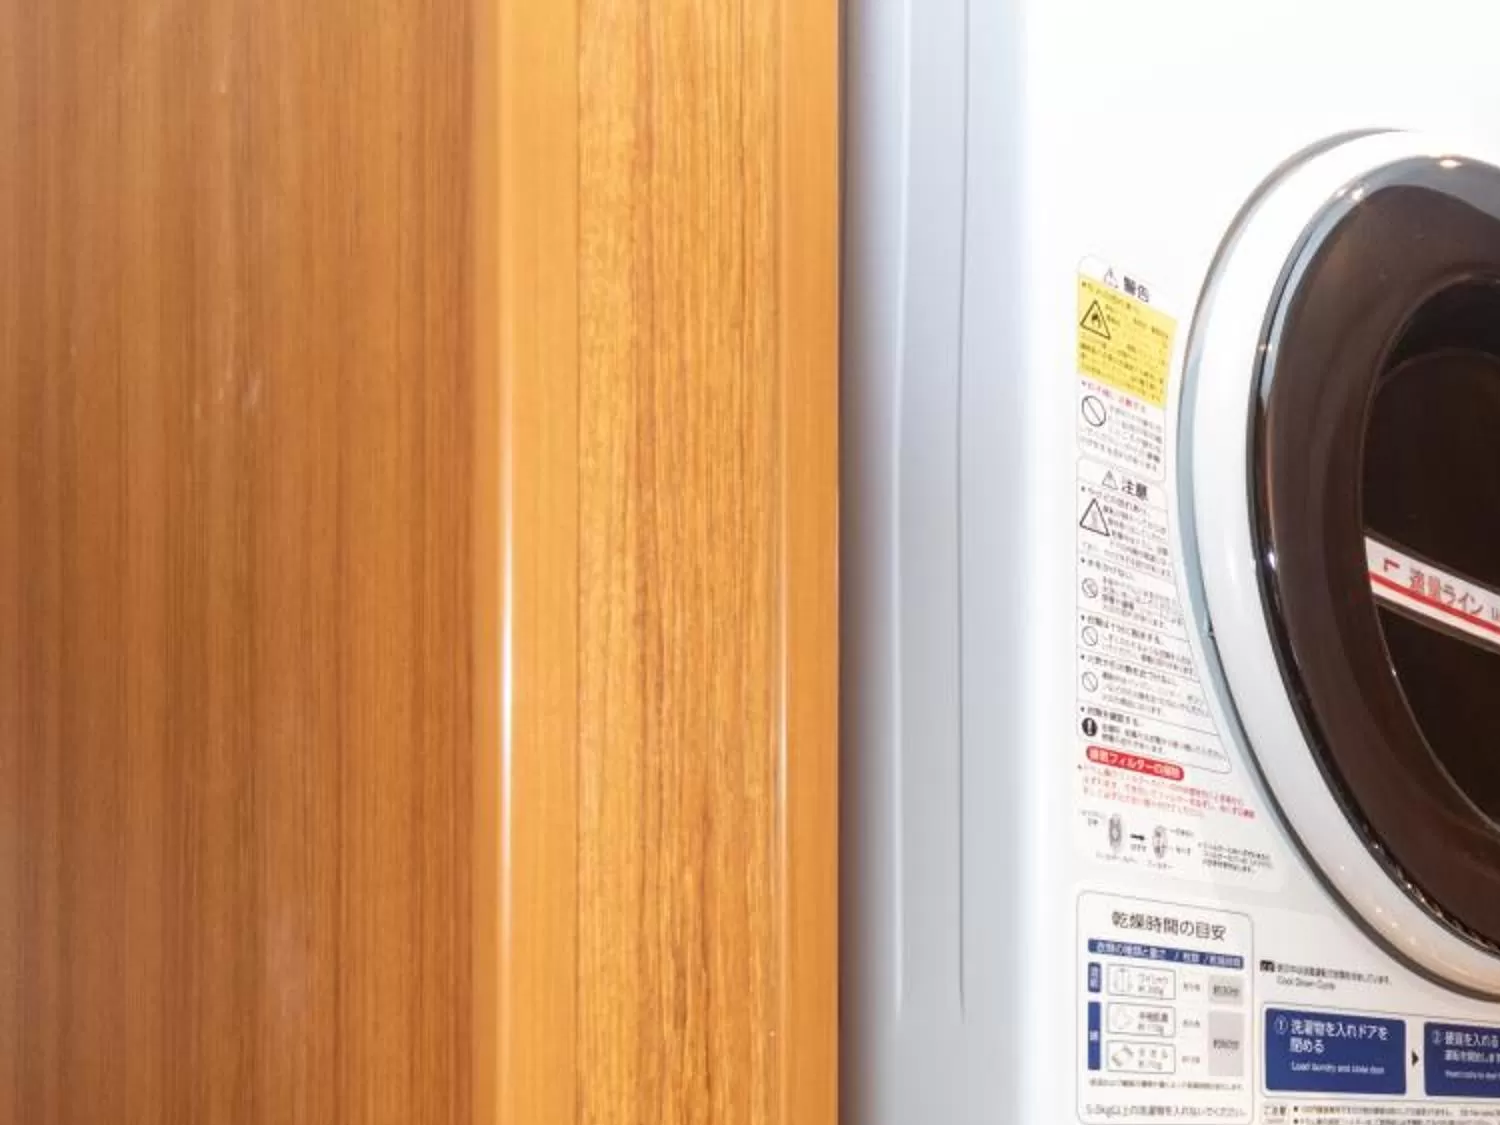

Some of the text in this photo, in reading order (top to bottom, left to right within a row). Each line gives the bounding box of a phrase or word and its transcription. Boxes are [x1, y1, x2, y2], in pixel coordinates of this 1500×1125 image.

[1111, 911, 1227, 941] 乾燥時間の目安
